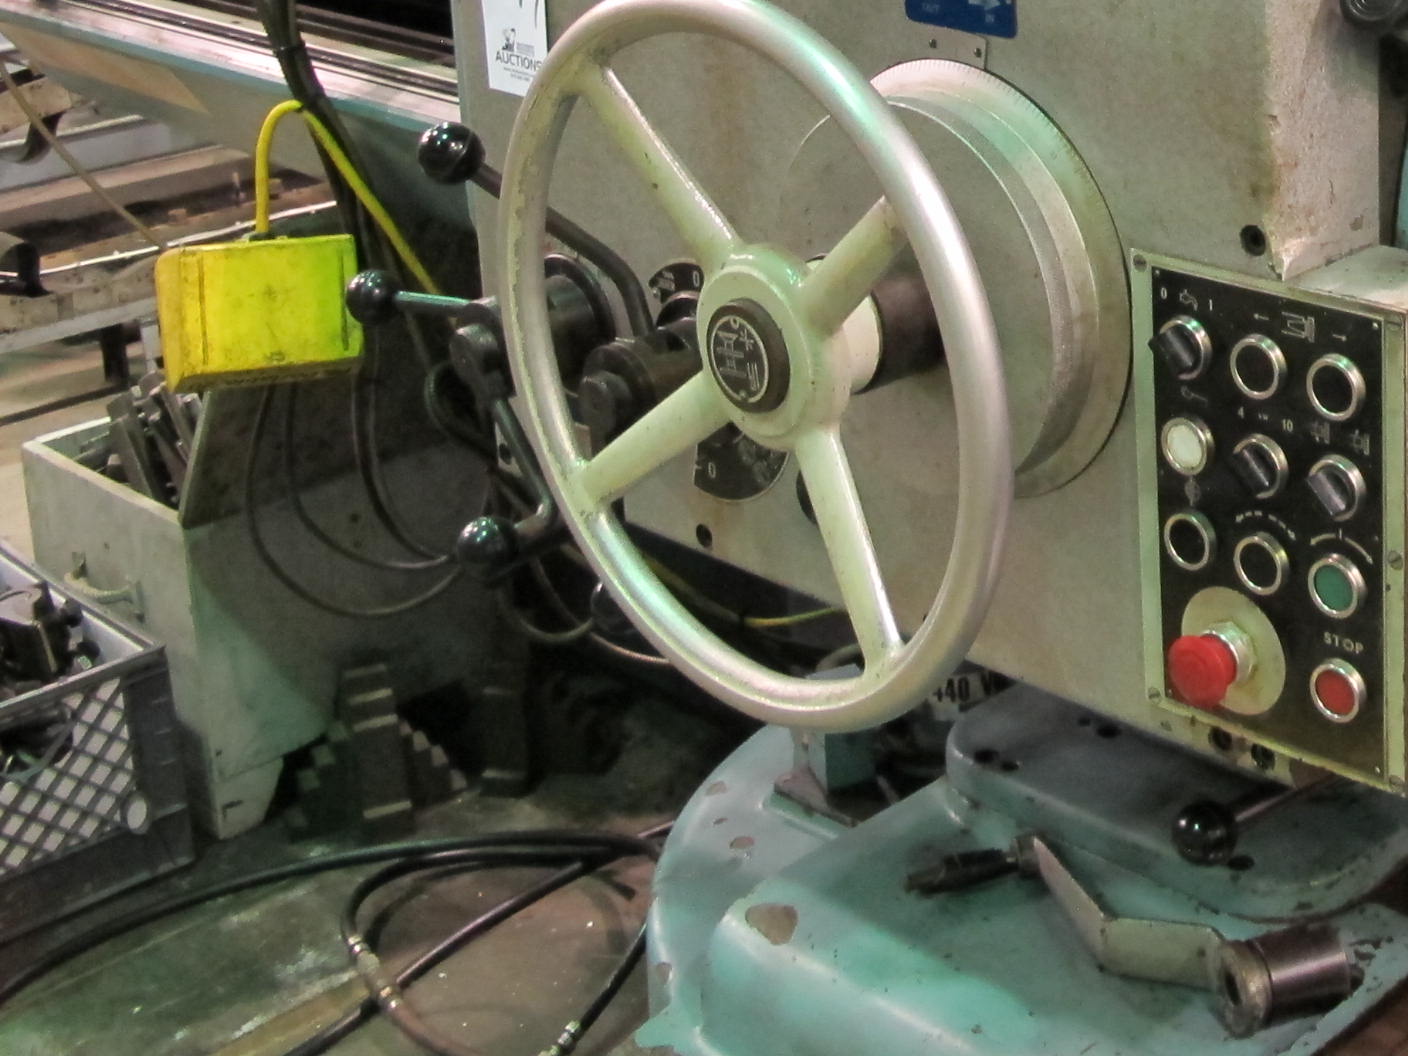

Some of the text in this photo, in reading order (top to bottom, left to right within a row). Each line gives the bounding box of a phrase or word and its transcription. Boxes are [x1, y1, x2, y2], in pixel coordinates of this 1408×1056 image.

[1237, 406, 1245, 419] 4
[1282, 419, 1294, 433] 10
[1323, 631, 1364, 654] STOP
